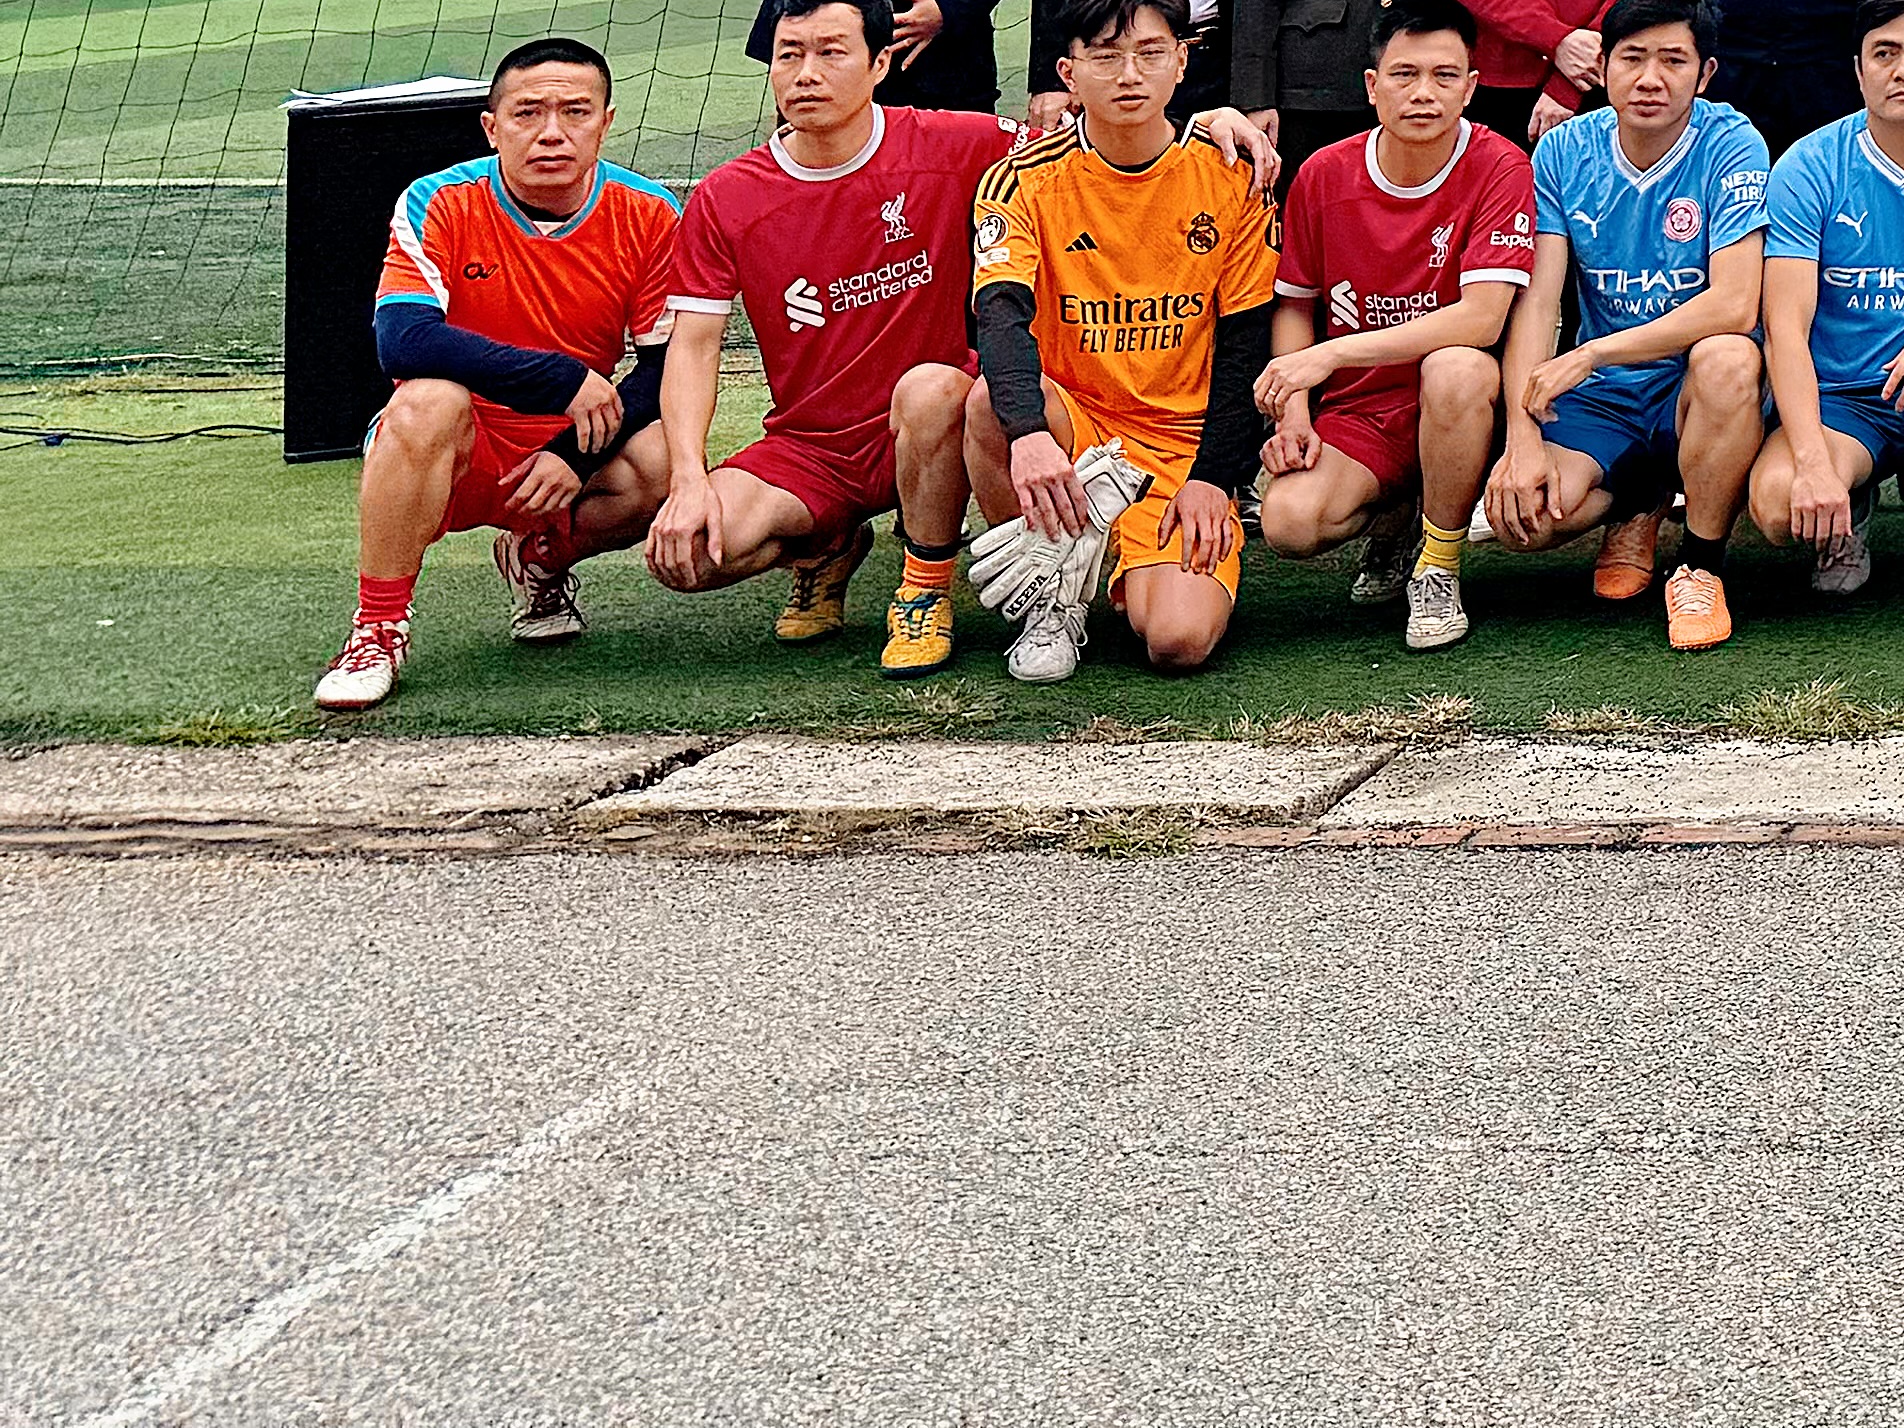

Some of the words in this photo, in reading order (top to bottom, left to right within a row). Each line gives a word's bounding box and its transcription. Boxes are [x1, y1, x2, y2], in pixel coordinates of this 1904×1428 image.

[827, 248, 929, 299] standard
[831, 264, 933, 313] chartered
[1585, 267, 1706, 294] TIHAD
[1059, 291, 1205, 326] Emirates
[1079, 328, 1109, 354] FLY
[1113, 323, 1185, 354] BETTER
